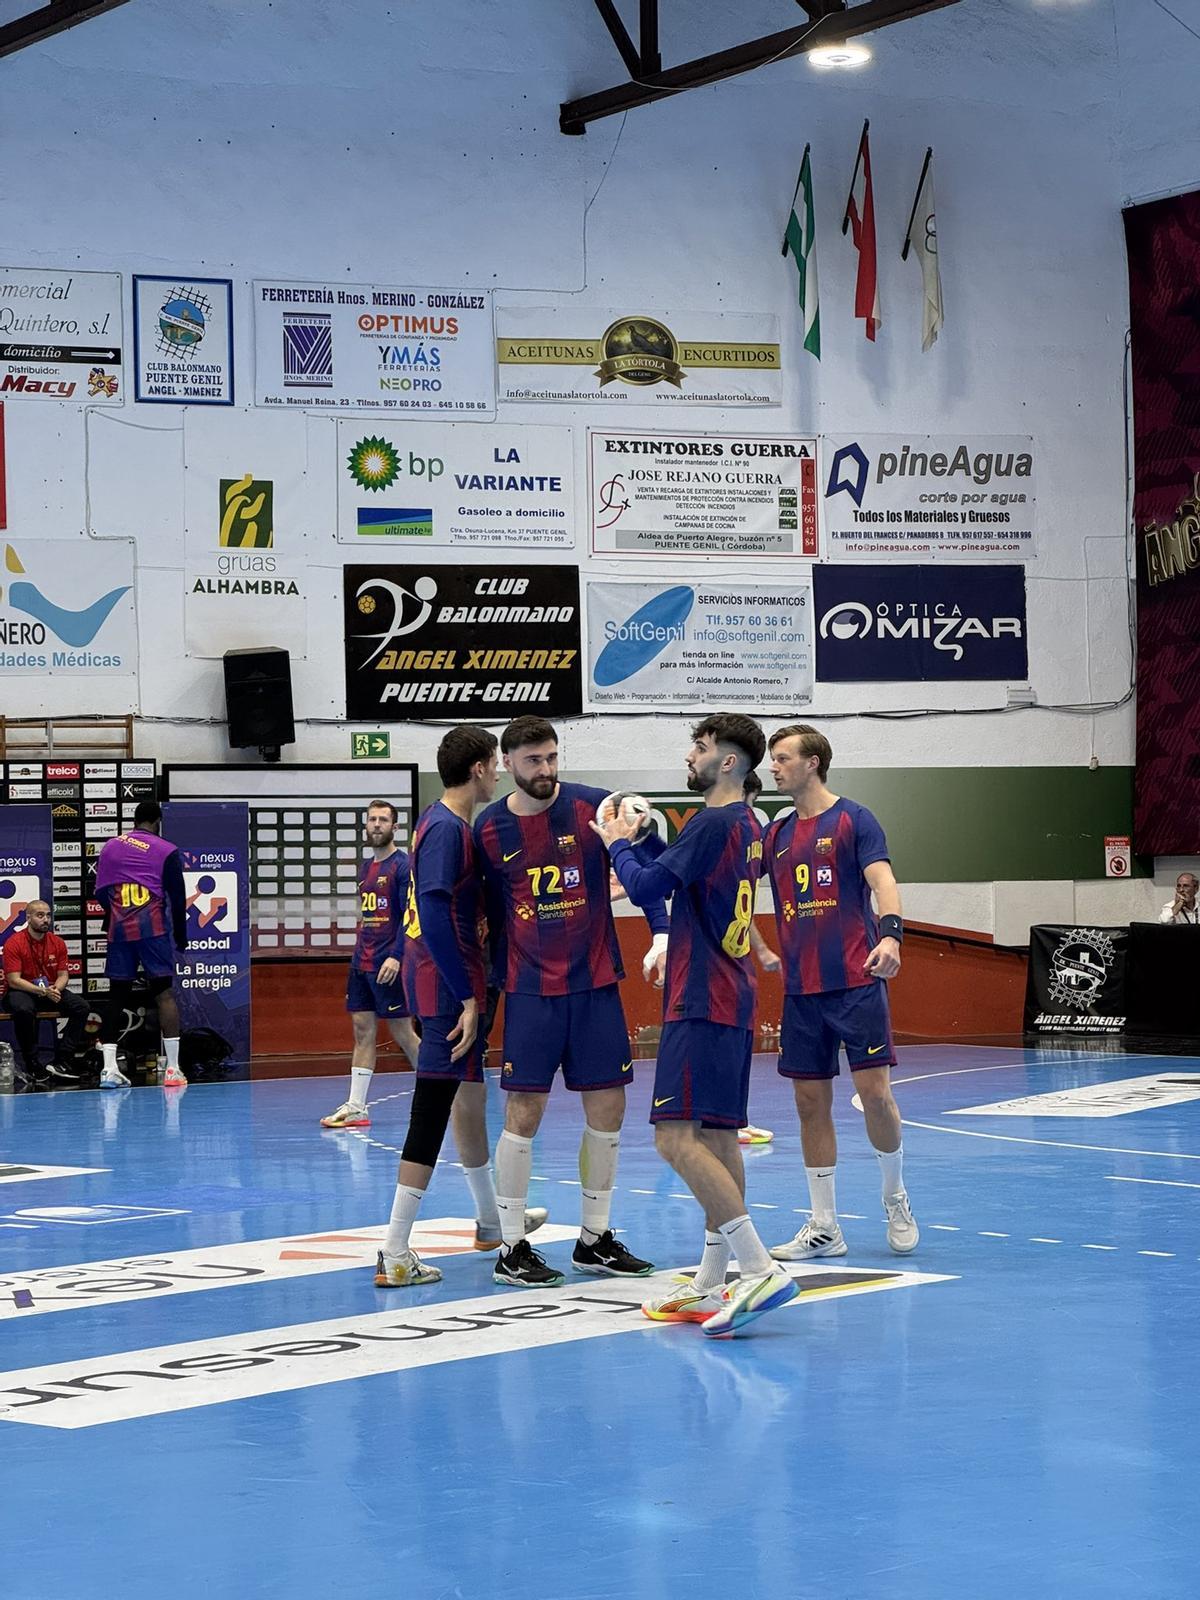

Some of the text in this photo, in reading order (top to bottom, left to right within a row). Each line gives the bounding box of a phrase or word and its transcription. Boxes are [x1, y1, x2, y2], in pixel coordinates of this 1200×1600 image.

[262, 286, 485, 310] FERRETERÍA Hnos. MERINO GONZÁLEZ
[0, 308, 80, 335] Quintero,
[358, 314, 458, 334] OPTIMUS
[4, 344, 62, 360] domicilio
[378, 342, 440, 366] YMÁS
[507, 345, 775, 362] ACEITUNAS ENCURTIDOS
[148, 362, 222, 372] CLUB BALONMANO
[614, 357, 666, 370] LA TÓRTOLA
[8, 366, 60, 376] Distribuidor:
[146, 372, 223, 385] PUENTE GENIL
[380, 378, 442, 391] NEOPRO
[1, 375, 76, 398] Macy
[148, 386, 222, 397] ANGEL XIMENEZ
[506, 388, 770, 402] info@aceitunaslatortola.com www.aceitunaslatortola.com
[494, 448, 520, 463] LA
[605, 440, 810, 458] EXTINTORES GUERRA
[409, 452, 444, 482] bp
[876, 445, 1033, 484] pineAgua
[454, 474, 562, 492] VARIANTE
[628, 470, 782, 484] JOSE REJANO GUERRA
[919, 492, 1026, 505] corte por agua
[458, 507, 502, 516] Gasoleo
[516, 508, 565, 517] domicilio
[802, 504, 816, 512] 957
[853, 510, 1010, 524] Todos los Materiales y Gruesos
[385, 525, 423, 535] ultimate
[706, 534, 736, 543] Alegre,
[728, 542, 766, 551] Córdoba)
[938, 543, 1020, 551] www.pineagua.com
[217, 554, 276, 575] grúas
[193, 578, 300, 596] ALHAMBRA
[474, 578, 529, 595] CLUB
[698, 596, 806, 606] SERVICIOS INFORMATICOS
[436, 606, 574, 623] BALONMANO
[877, 602, 962, 617] ÓPTICA
[706, 615, 793, 626] Tlf. 957 60 36 61
[604, 621, 685, 642] SoftGenil
[694, 630, 805, 644] info@softgenil.com
[877, 618, 1022, 660] MIZAR
[53, 652, 121, 666] Médicas
[375, 650, 577, 670] ANGEL XIMENEZ
[380, 682, 551, 702] PUENTE-GENIL
[0, 854, 234, 866] nexus nexus
[526, 866, 563, 896] 72
[796, 864, 809, 892] 9
[122, 884, 150, 906] 10
[362, 892, 377, 911] 20
[537, 898, 586, 911] Assistència
[798, 898, 836, 909] Assistència
[722, 880, 752, 958] 8
[176, 963, 237, 975] La Buena
[182, 976, 231, 990] energía
[1034, 1012, 1127, 1026] ÁNGEL XIMENEZ
